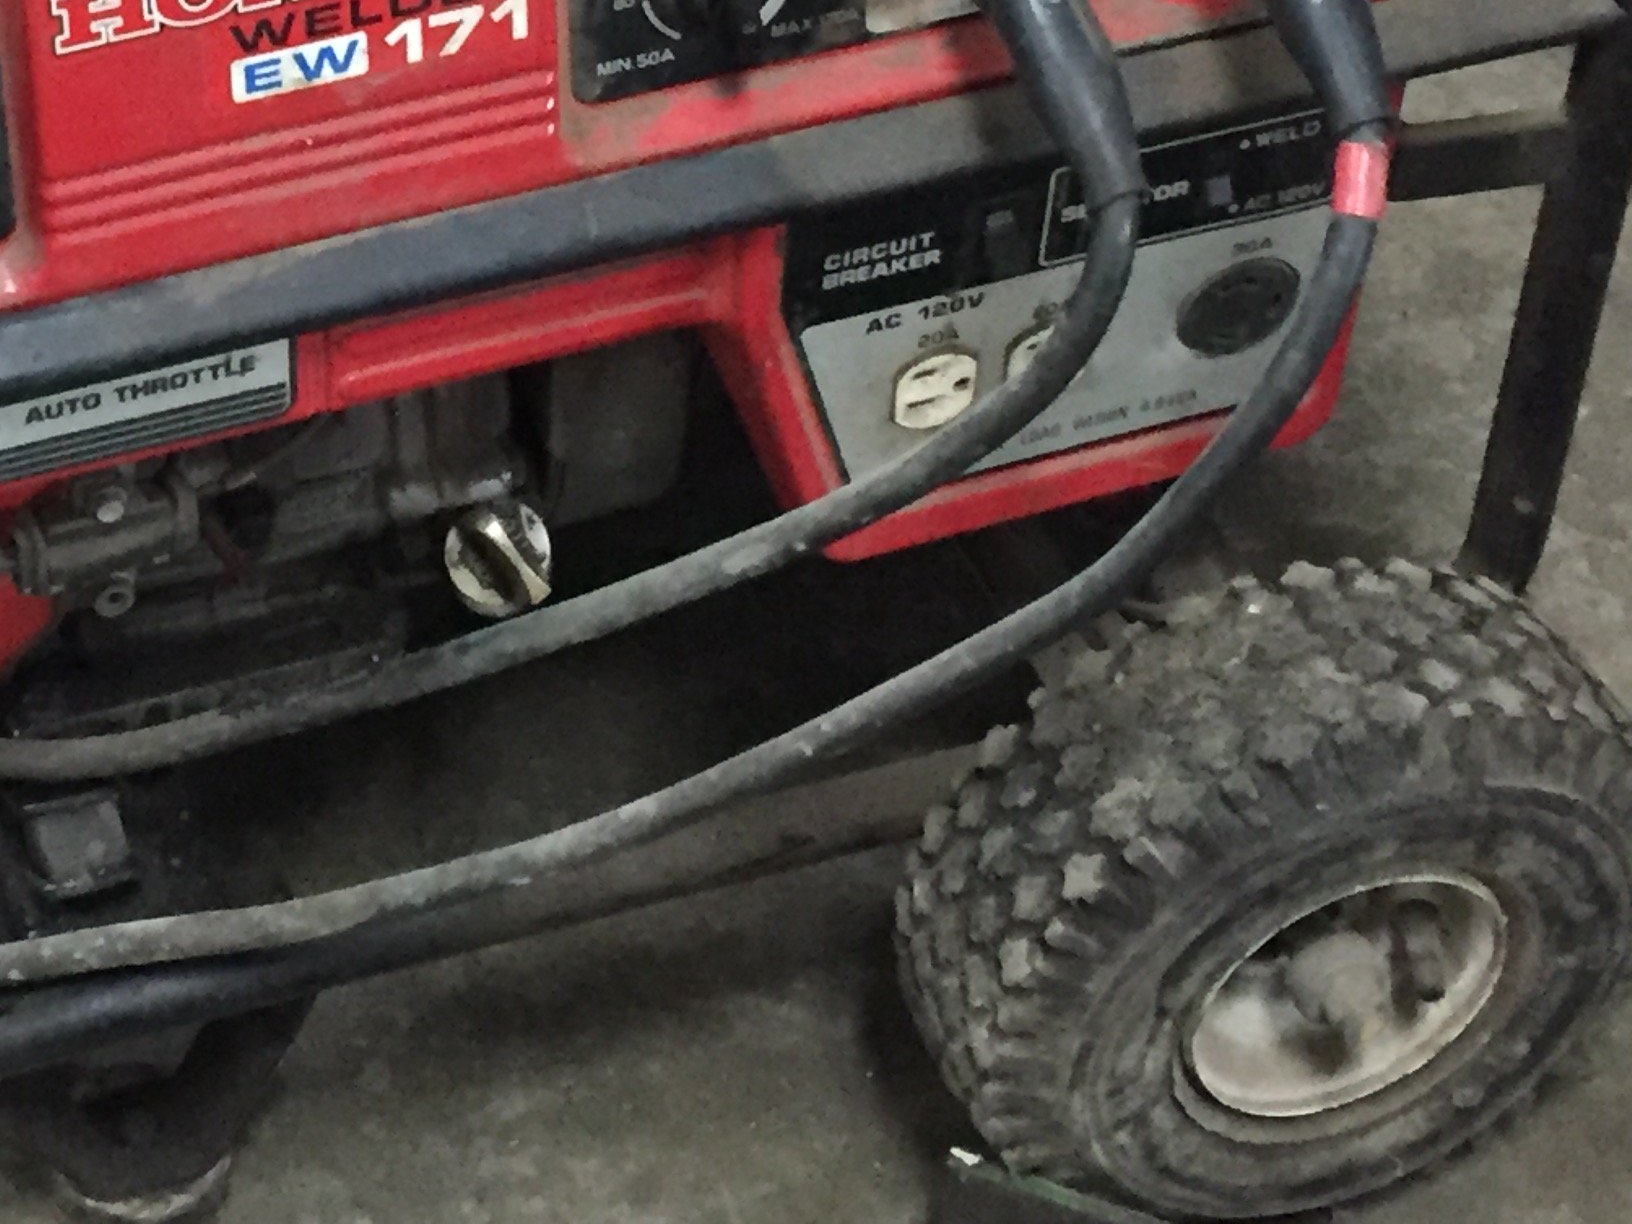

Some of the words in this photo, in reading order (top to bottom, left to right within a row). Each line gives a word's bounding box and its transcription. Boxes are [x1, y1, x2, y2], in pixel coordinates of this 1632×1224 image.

[244, 41, 359, 94] EW
[822, 249, 942, 289] BREAKER
[824, 232, 935, 271] CIRCUIT
[866, 313, 902, 335] AC
[919, 292, 985, 320] 120V
[24, 392, 102, 426] AUTO
[114, 354, 258, 404] THROTTLE
